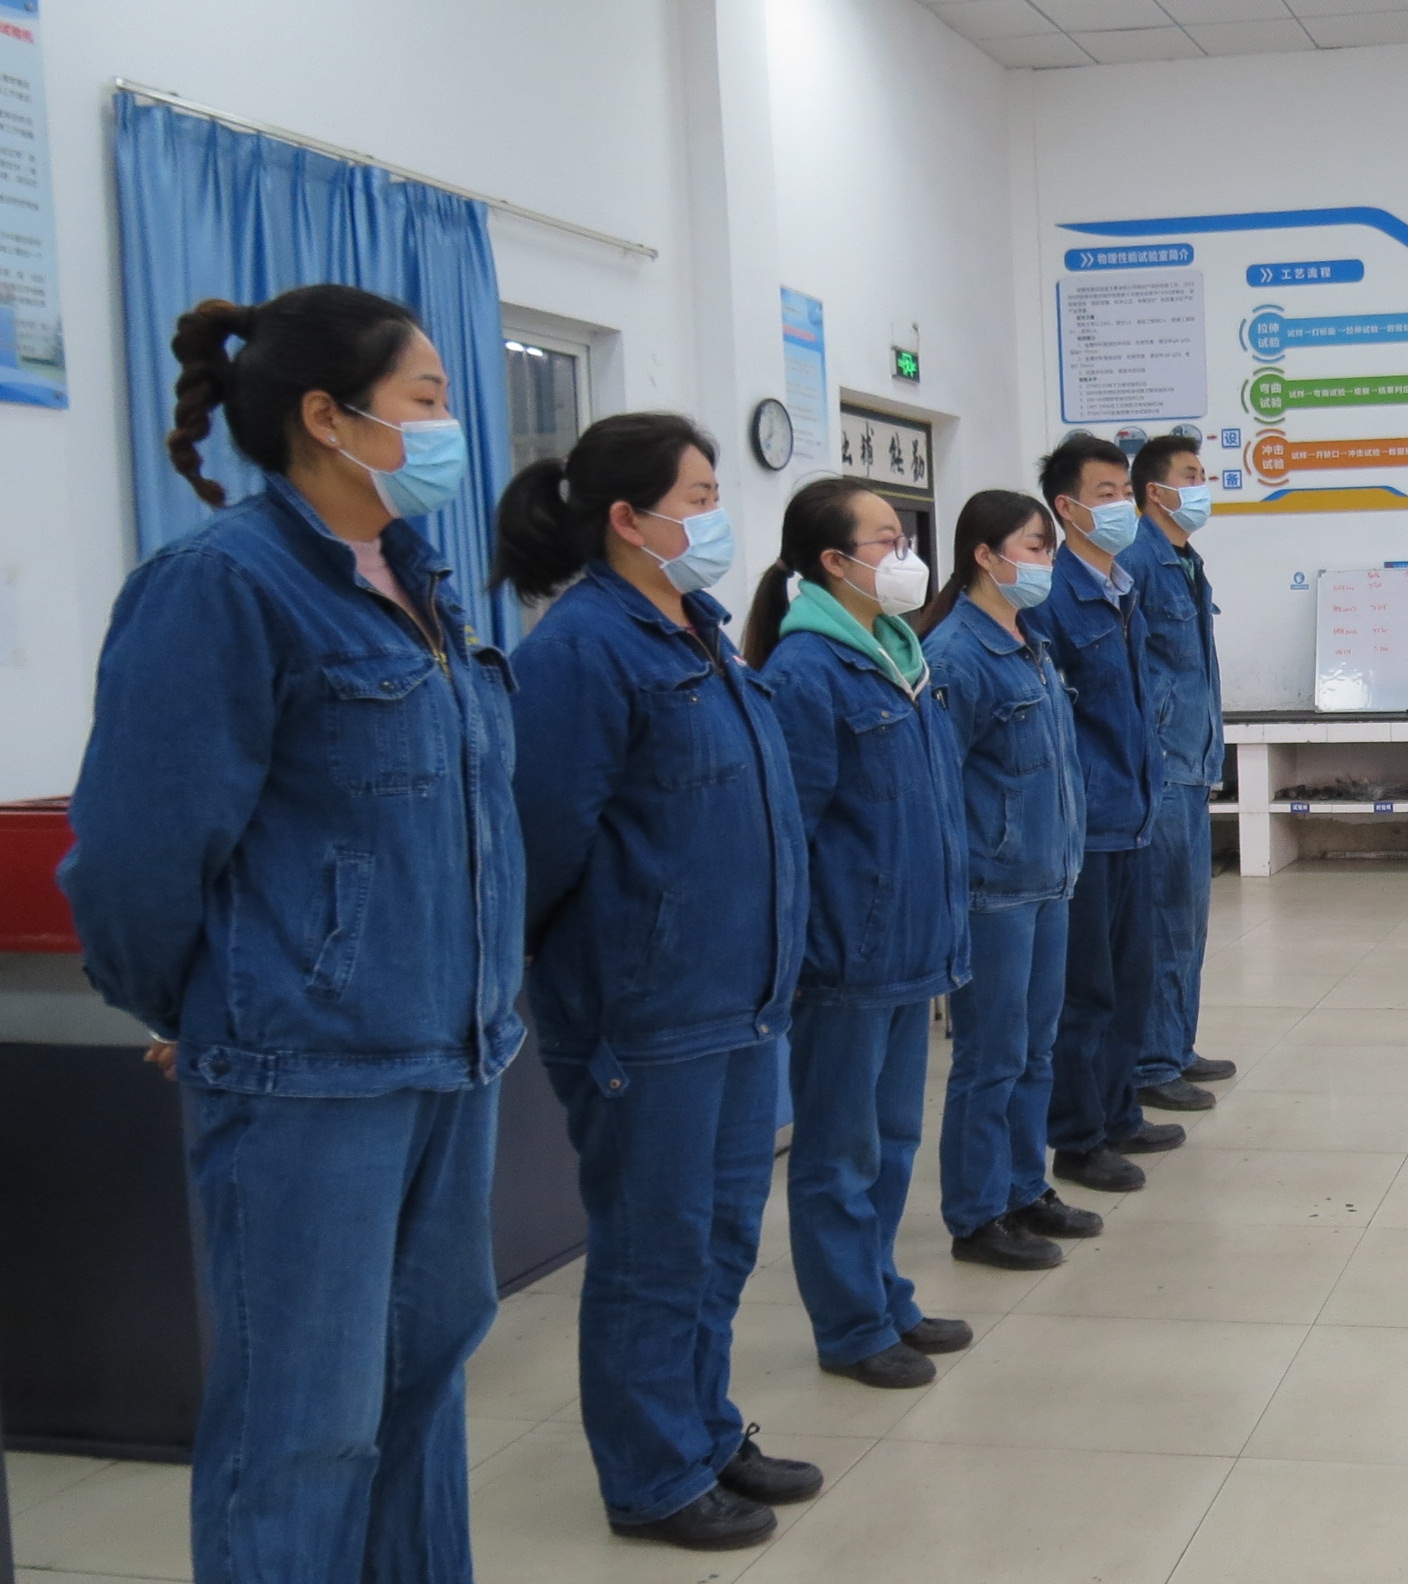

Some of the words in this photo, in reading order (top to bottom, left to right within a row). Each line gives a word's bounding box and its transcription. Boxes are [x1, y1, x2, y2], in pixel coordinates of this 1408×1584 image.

[1281, 267, 1332, 281] 工艺流程
[1257, 323, 1280, 334] 拉伸
[1257, 337, 1280, 348] 试验
[1259, 383, 1282, 394] 弯曲
[1260, 397, 1282, 408] 试验
[1224, 432, 1238, 445] 设
[1262, 445, 1284, 455] 冲击
[1262, 459, 1284, 470] 试验
[1225, 473, 1239, 486] 备
